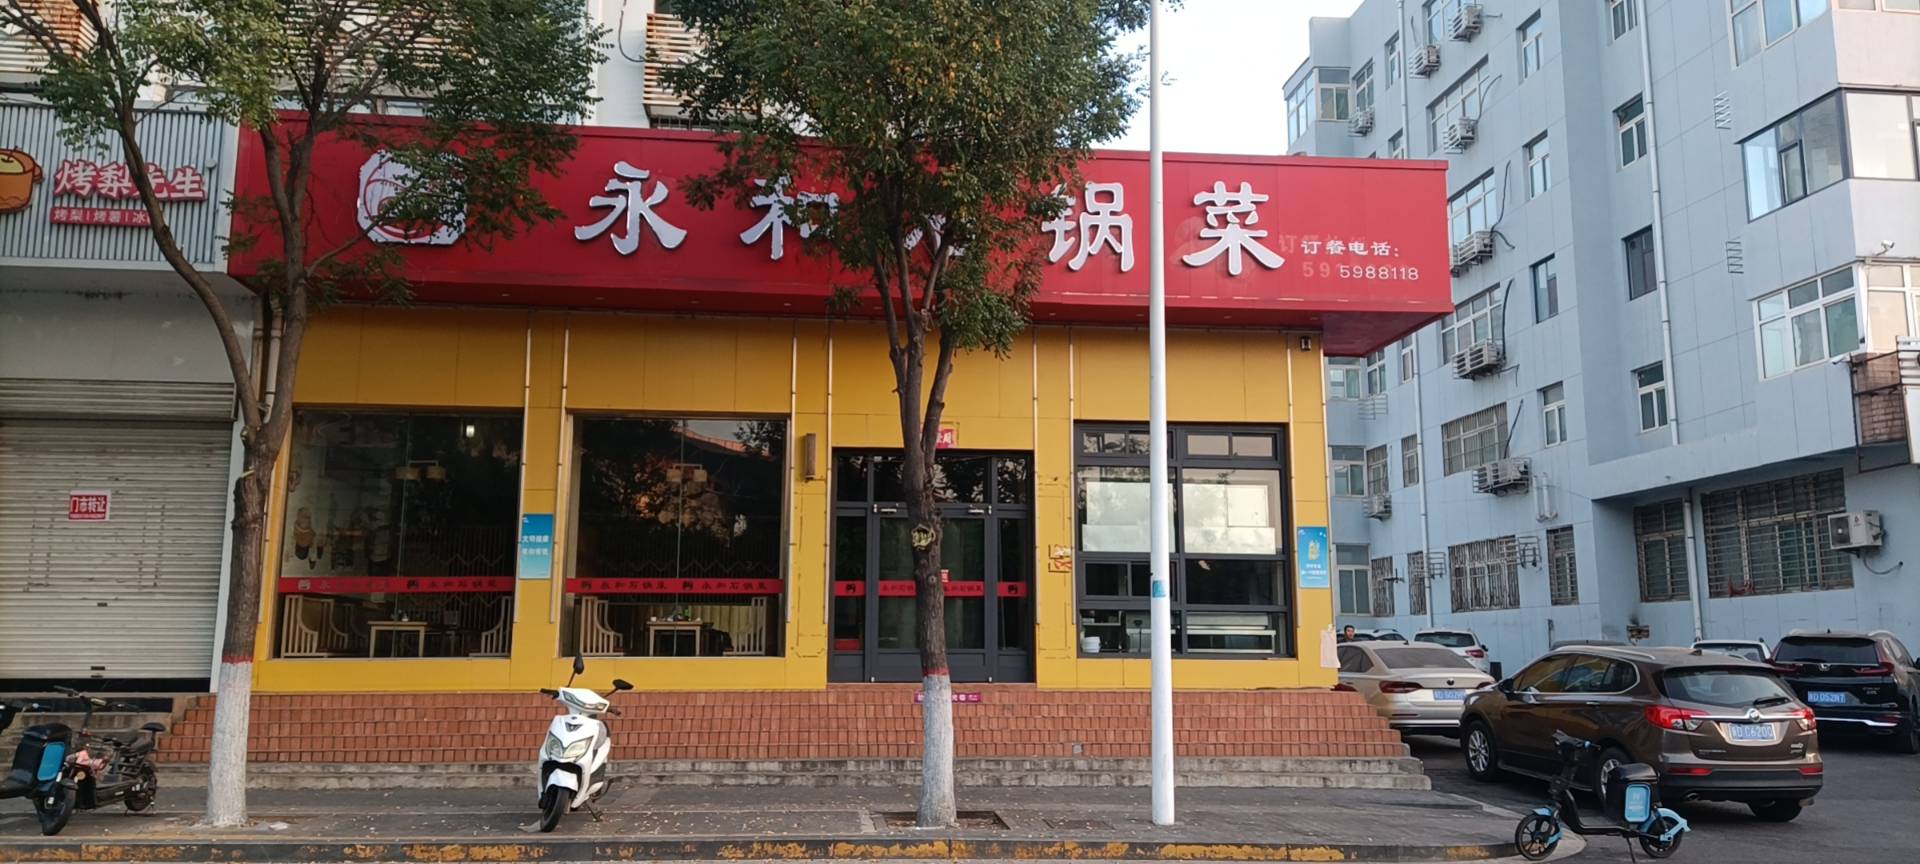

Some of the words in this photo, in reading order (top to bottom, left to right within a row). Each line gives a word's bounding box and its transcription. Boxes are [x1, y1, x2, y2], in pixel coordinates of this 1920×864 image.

[575, 160, 1286, 276] 永和锅菜
[1339, 265, 1419, 281] 5988118
[70, 496, 106, 513] 门市转让
